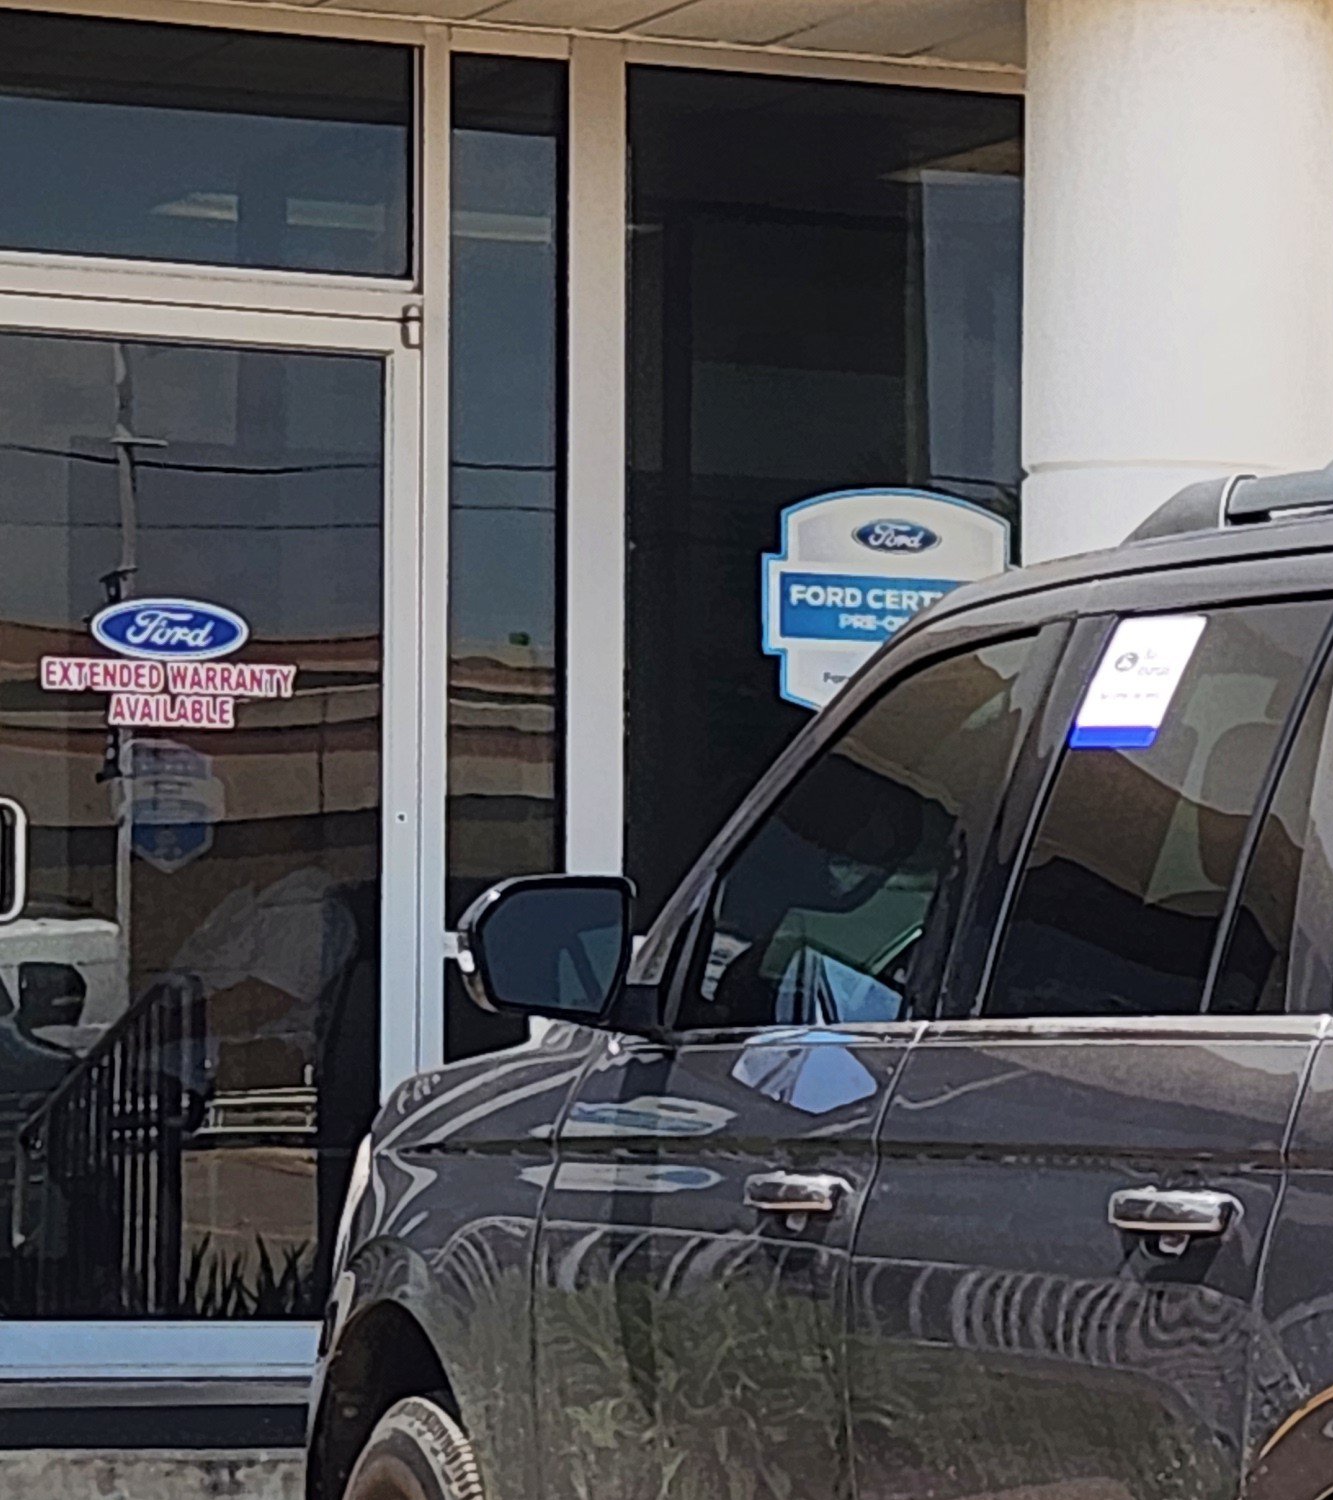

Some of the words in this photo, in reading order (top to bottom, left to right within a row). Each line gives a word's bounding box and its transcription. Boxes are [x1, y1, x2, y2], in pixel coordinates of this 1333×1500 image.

[868, 523, 924, 548] Ford
[789, 584, 862, 607] FORD
[126, 610, 213, 647] Ford
[45, 661, 162, 688] EXTENDED
[169, 664, 294, 695] WARRANTY
[112, 696, 231, 725] AVAILABLE
